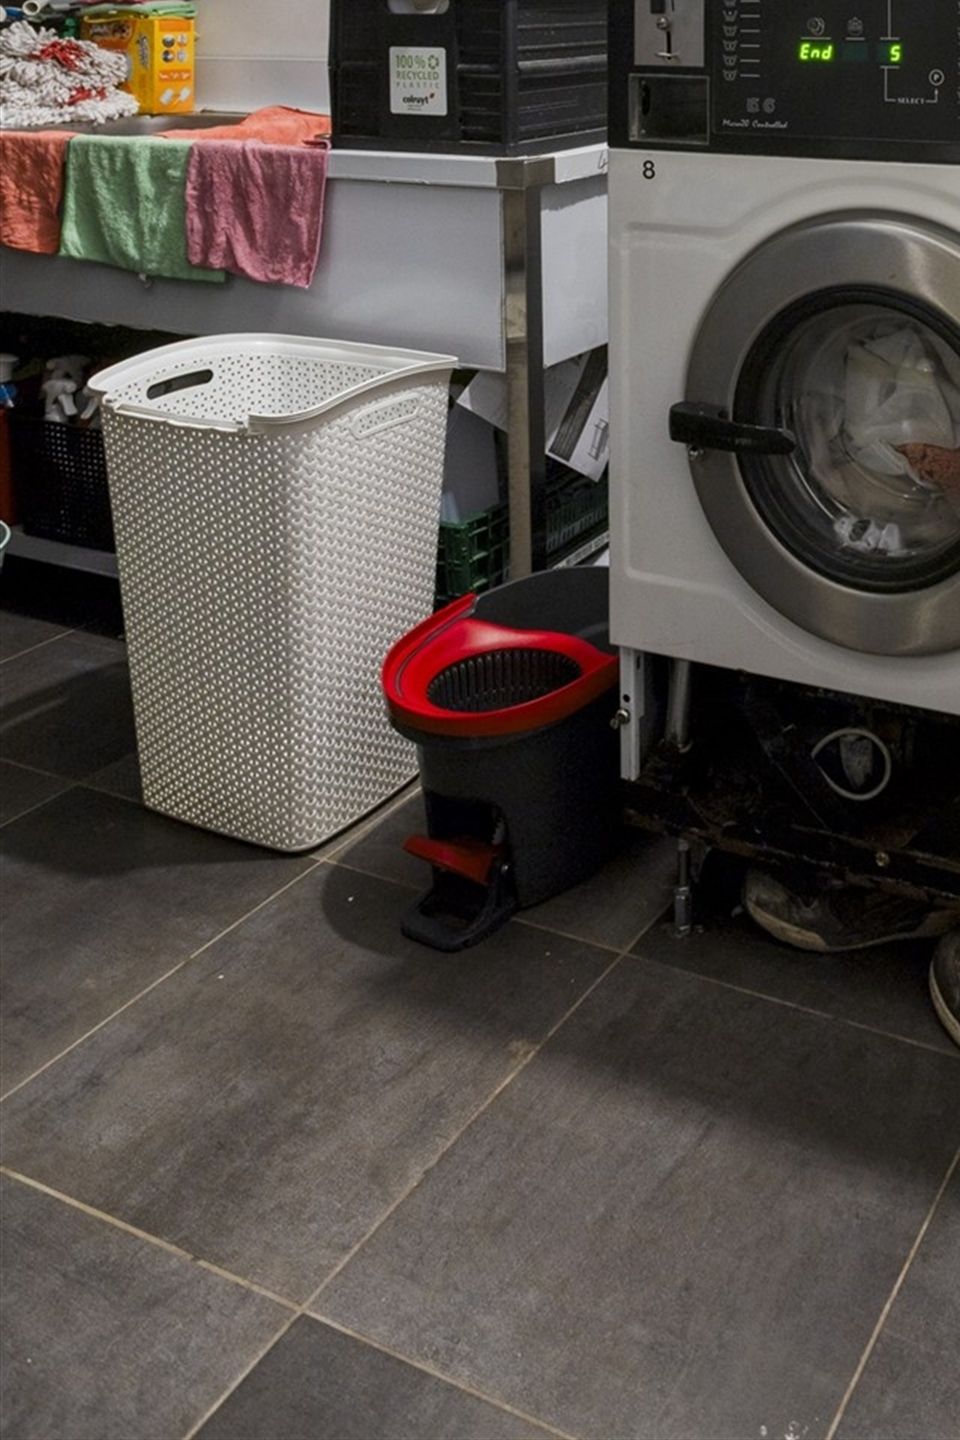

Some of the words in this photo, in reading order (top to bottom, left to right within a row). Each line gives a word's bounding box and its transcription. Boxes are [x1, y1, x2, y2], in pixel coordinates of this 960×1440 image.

[800, 43, 832, 60] End
[890, 45, 900, 61] 5
[396, 54, 426, 69] 100%
[396, 70, 439, 80] RECYCLED
[402, 94, 429, 105] colruyt
[897, 97, 925, 105] SELECT
[642, 160, 656, 180] 8
